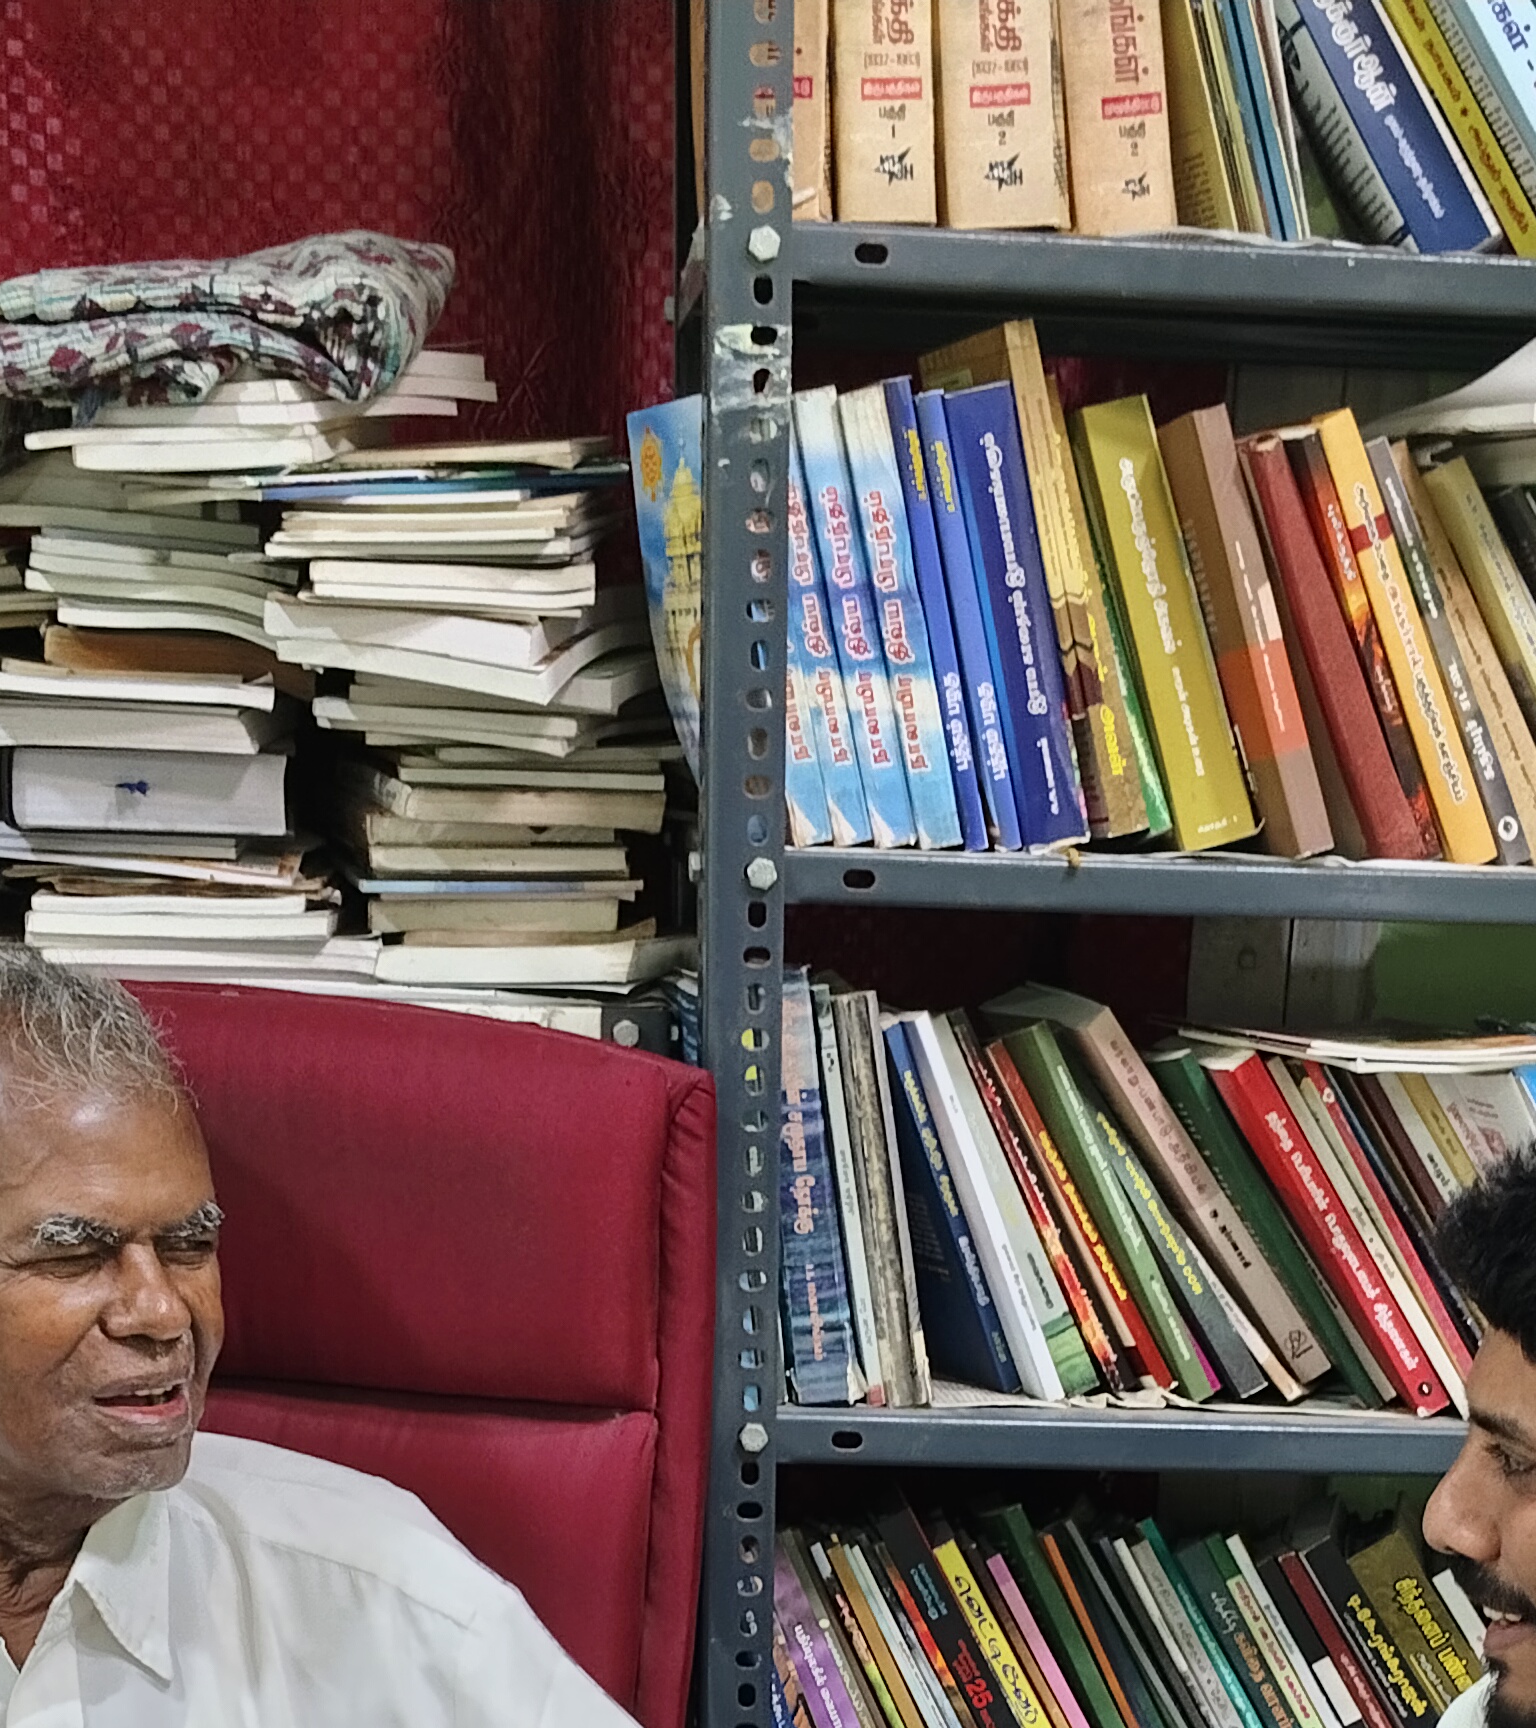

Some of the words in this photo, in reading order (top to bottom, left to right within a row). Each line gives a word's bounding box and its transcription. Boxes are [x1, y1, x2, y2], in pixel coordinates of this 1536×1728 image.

[823, 484, 857, 589] பிரபந்தம்
[866, 490, 899, 593] பிரபந்தம்
[842, 596, 874, 662] திவ்ய
[881, 599, 915, 664] திவ்ய
[815, 666, 850, 766] நாலாயிர
[857, 670, 892, 767] நாலாயிர
[892, 674, 927, 773] நாலாயிர
[962, 1675, 995, 1711] 25
